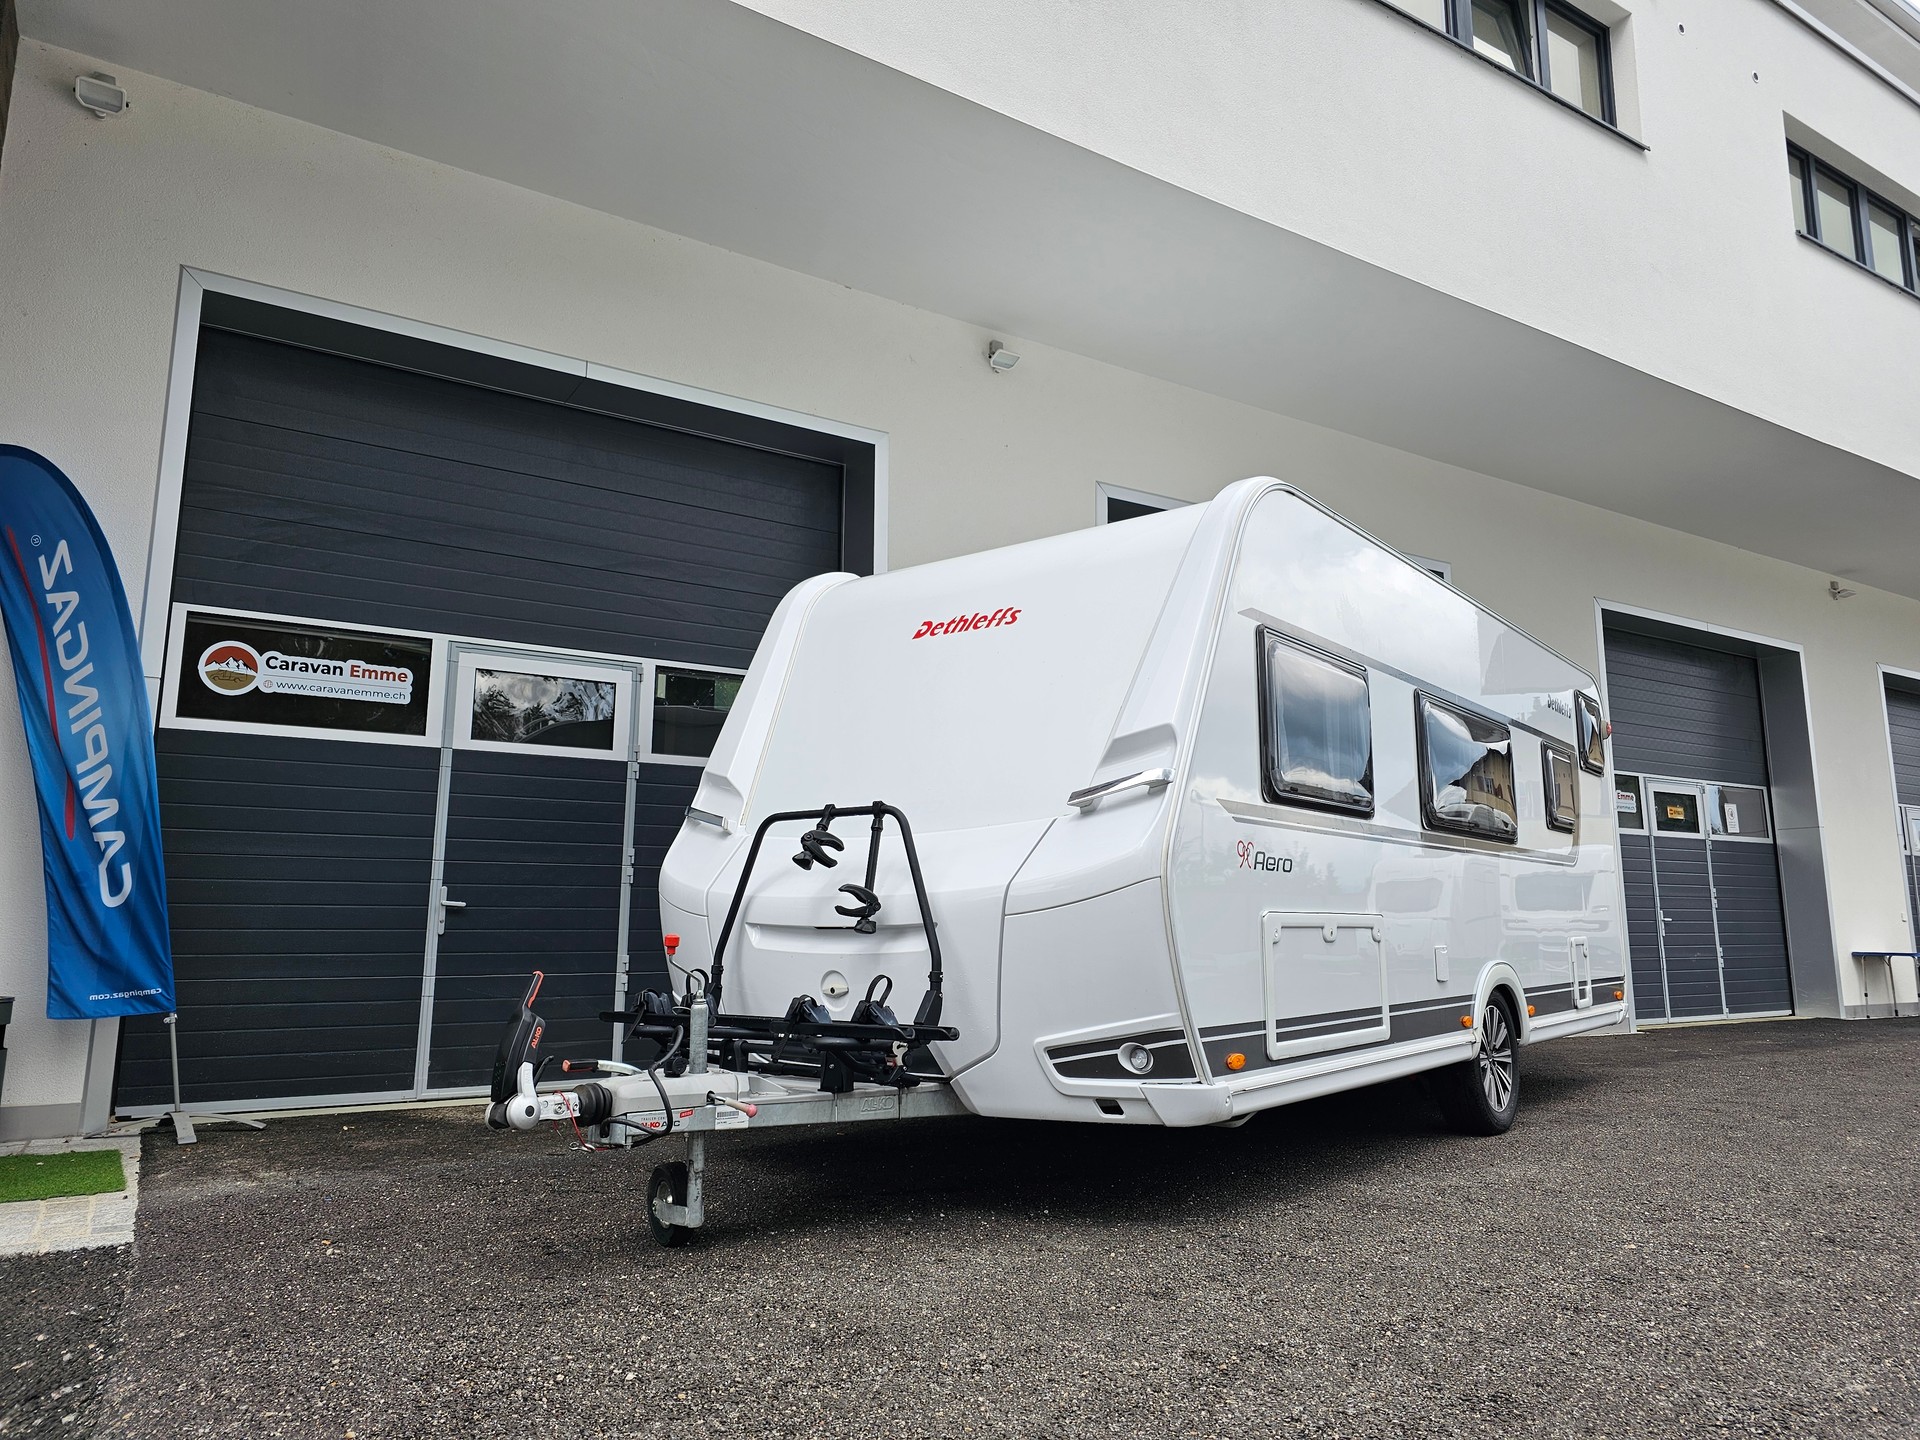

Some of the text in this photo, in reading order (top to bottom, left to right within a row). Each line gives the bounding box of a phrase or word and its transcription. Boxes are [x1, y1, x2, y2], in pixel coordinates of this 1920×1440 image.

[912, 607, 1022, 640] Dethleffs
[265, 656, 408, 683] Caravan Emme
[276, 681, 406, 700] www.caravanemme.ch
[1254, 851, 1293, 873] Aero
[661, 1120, 680, 1128] AC
